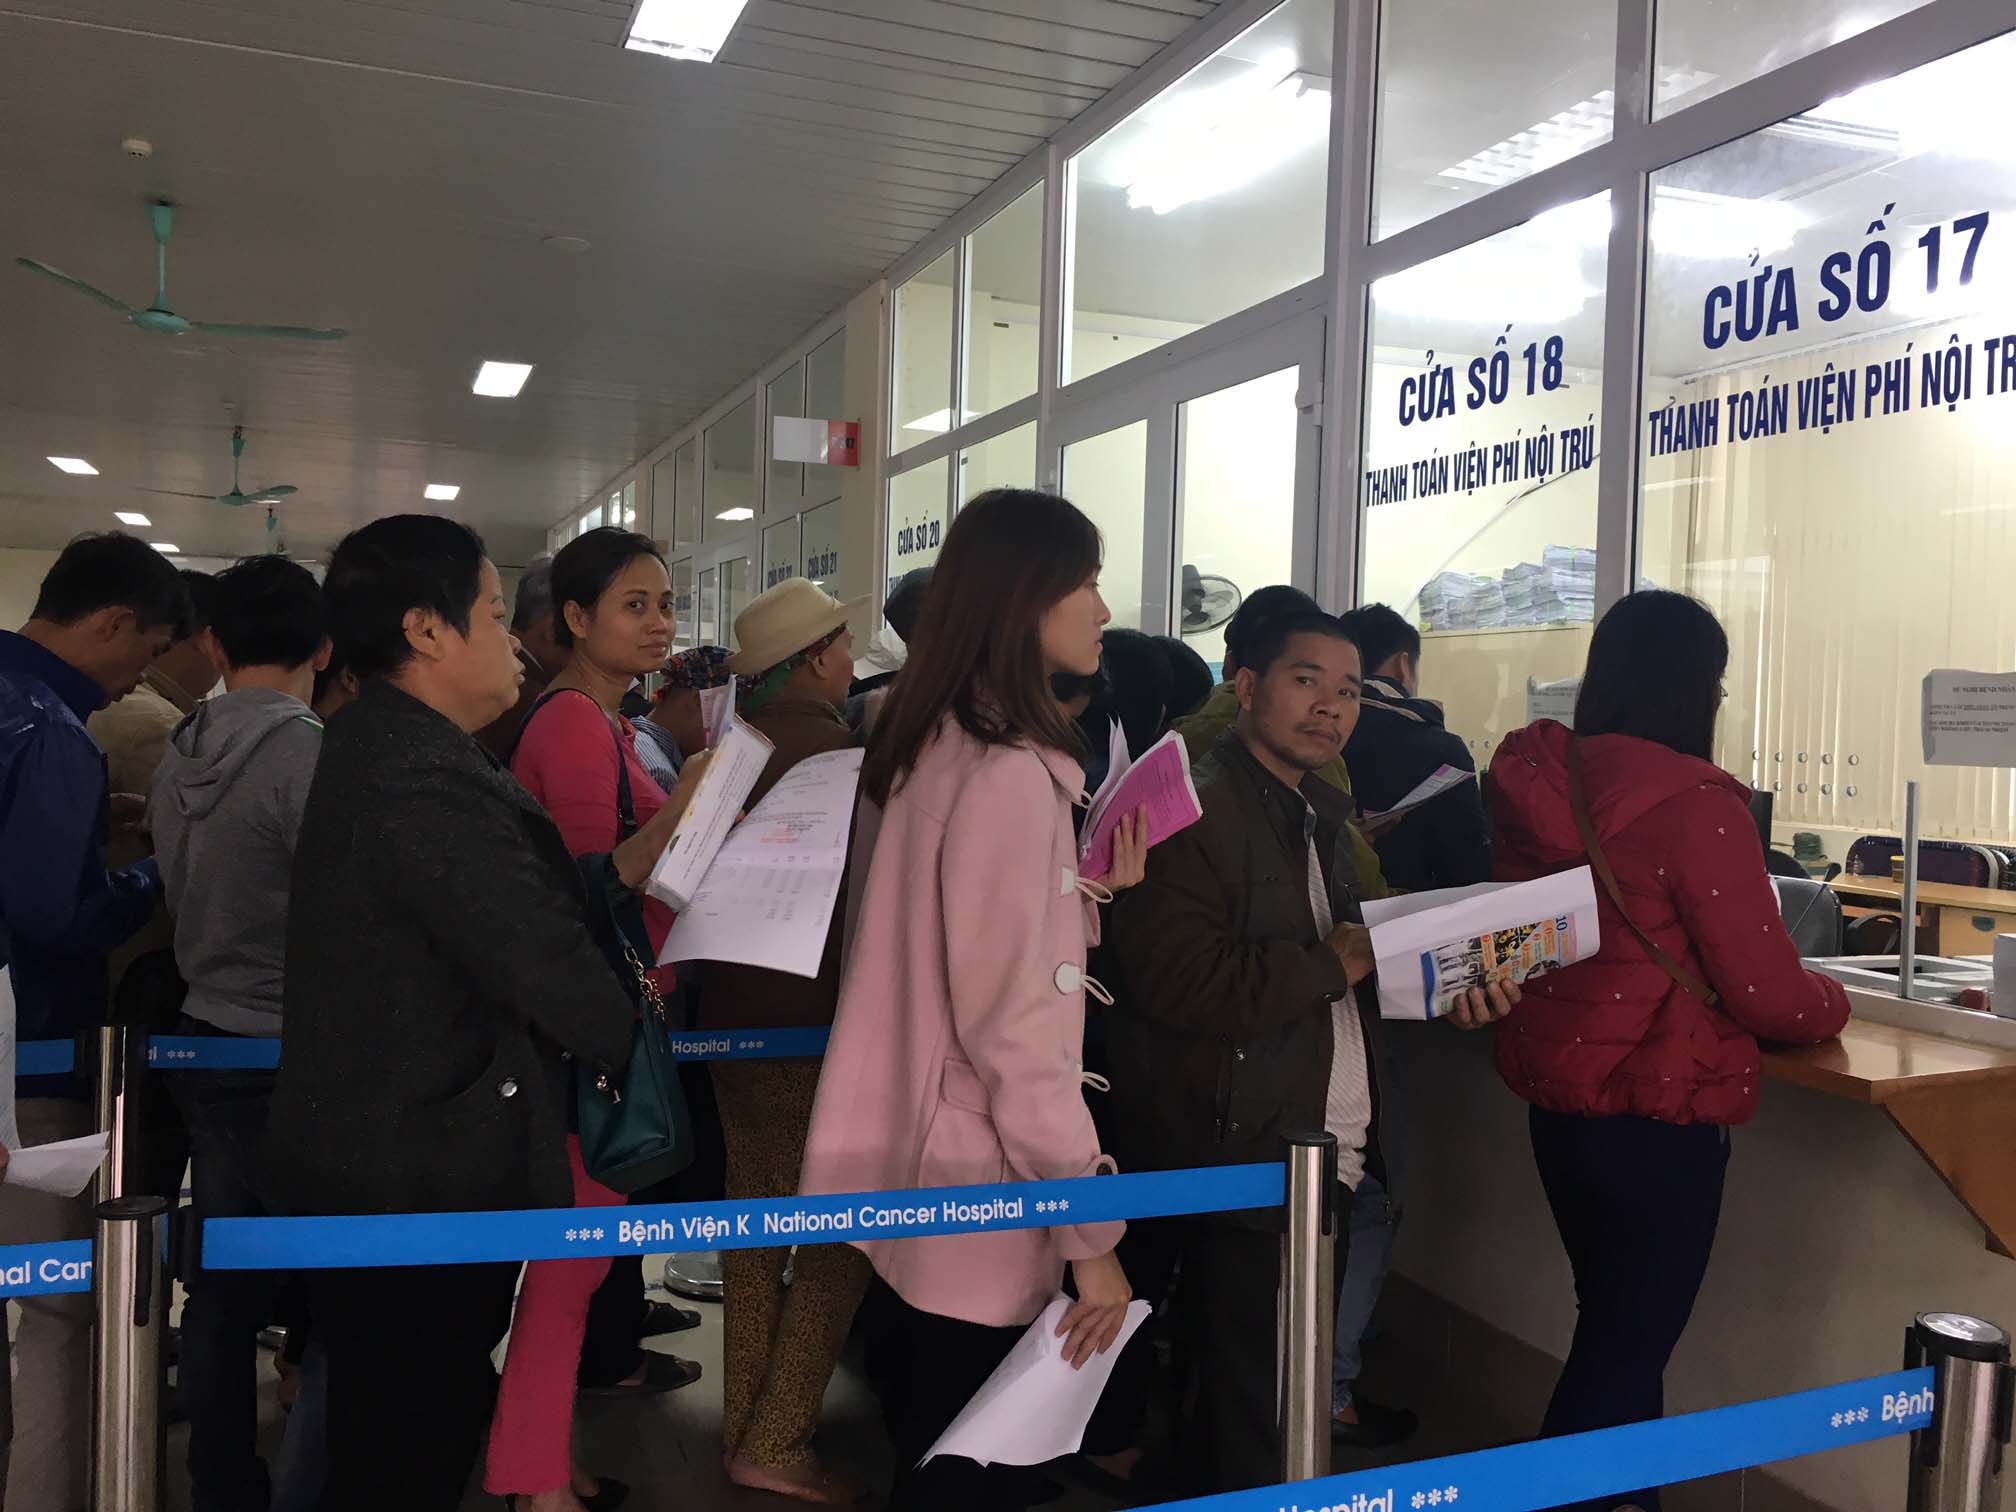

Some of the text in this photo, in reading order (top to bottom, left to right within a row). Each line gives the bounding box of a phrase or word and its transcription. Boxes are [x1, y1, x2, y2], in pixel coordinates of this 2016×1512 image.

[1703, 202, 1990, 350] CỬA SỐ 17
[1399, 324, 1563, 426] CỬA SỐ 18
[1649, 398, 1719, 457] THANH
[1727, 375, 1788, 443] TOÁN
[1797, 363, 1856, 434] VIỆN
[1864, 342, 1913, 418] PHÍ
[1920, 334, 1972, 412] NỘI
[1366, 413, 1594, 507] THANH TOÁN VIỆN PHÍ NỘI TRÚ
[929, 520, 940, 548] 20
[830, 552, 837, 575] 21
[672, 1039, 730, 1056] Hospital
[618, 1197, 1023, 1247] Bệnh Viện K National Cancer Hospital
[1882, 1386, 1935, 1424] Bệnh
